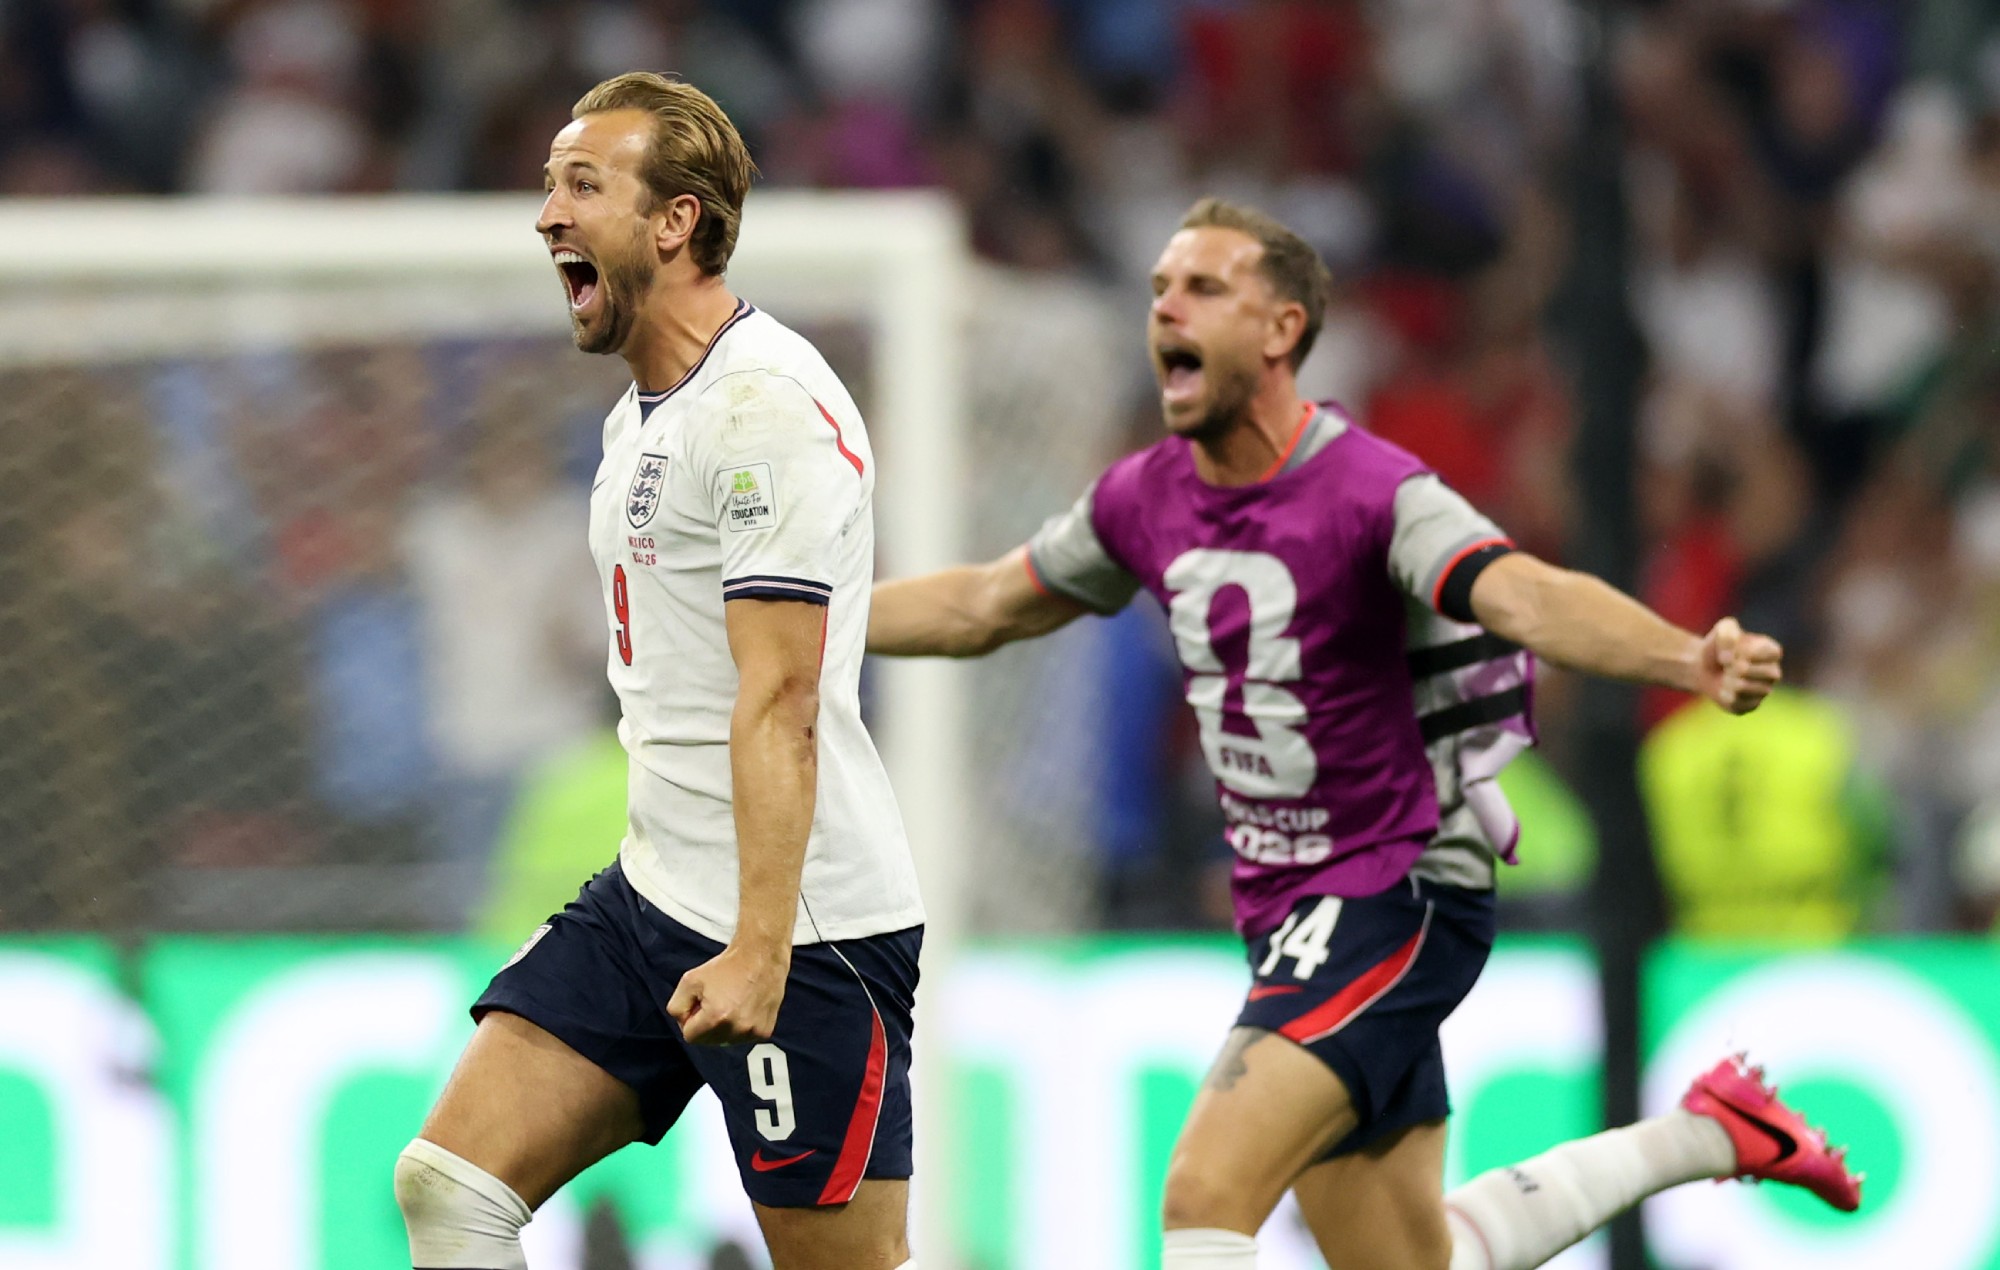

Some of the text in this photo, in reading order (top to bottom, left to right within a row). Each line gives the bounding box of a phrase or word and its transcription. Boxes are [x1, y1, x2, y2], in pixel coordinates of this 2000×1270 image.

[731, 505, 769, 520] EDUCATION
[613, 563, 633, 667] 9
[1274, 808, 1330, 832] CUP
[747, 1042, 796, 1142] 9
